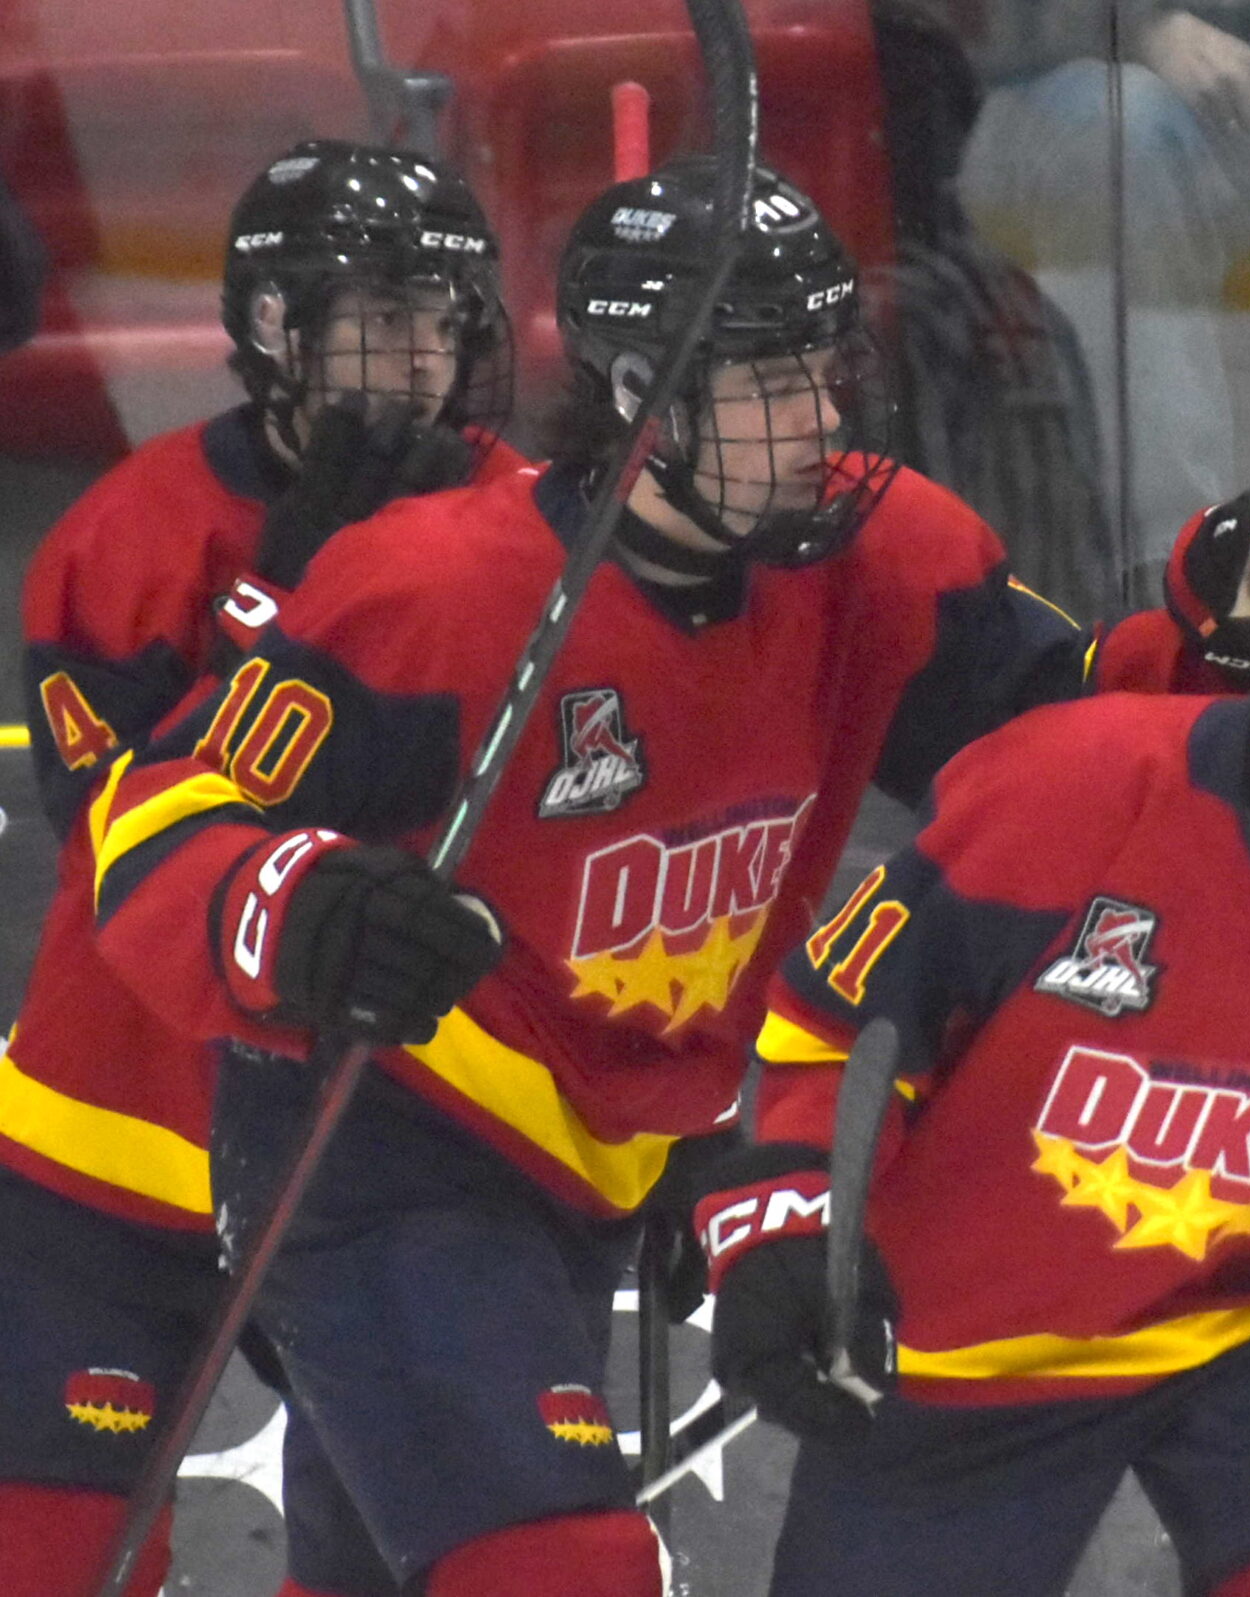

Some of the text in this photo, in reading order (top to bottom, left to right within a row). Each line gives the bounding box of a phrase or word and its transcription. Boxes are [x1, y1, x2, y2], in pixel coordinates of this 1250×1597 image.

[234, 231, 283, 252] CCM
[420, 230, 486, 254] CCM
[586, 299, 652, 318] CCM
[806, 278, 854, 312] CCM
[40, 670, 119, 772] 4
[192, 656, 334, 807] 10
[805, 864, 911, 1006] 11
